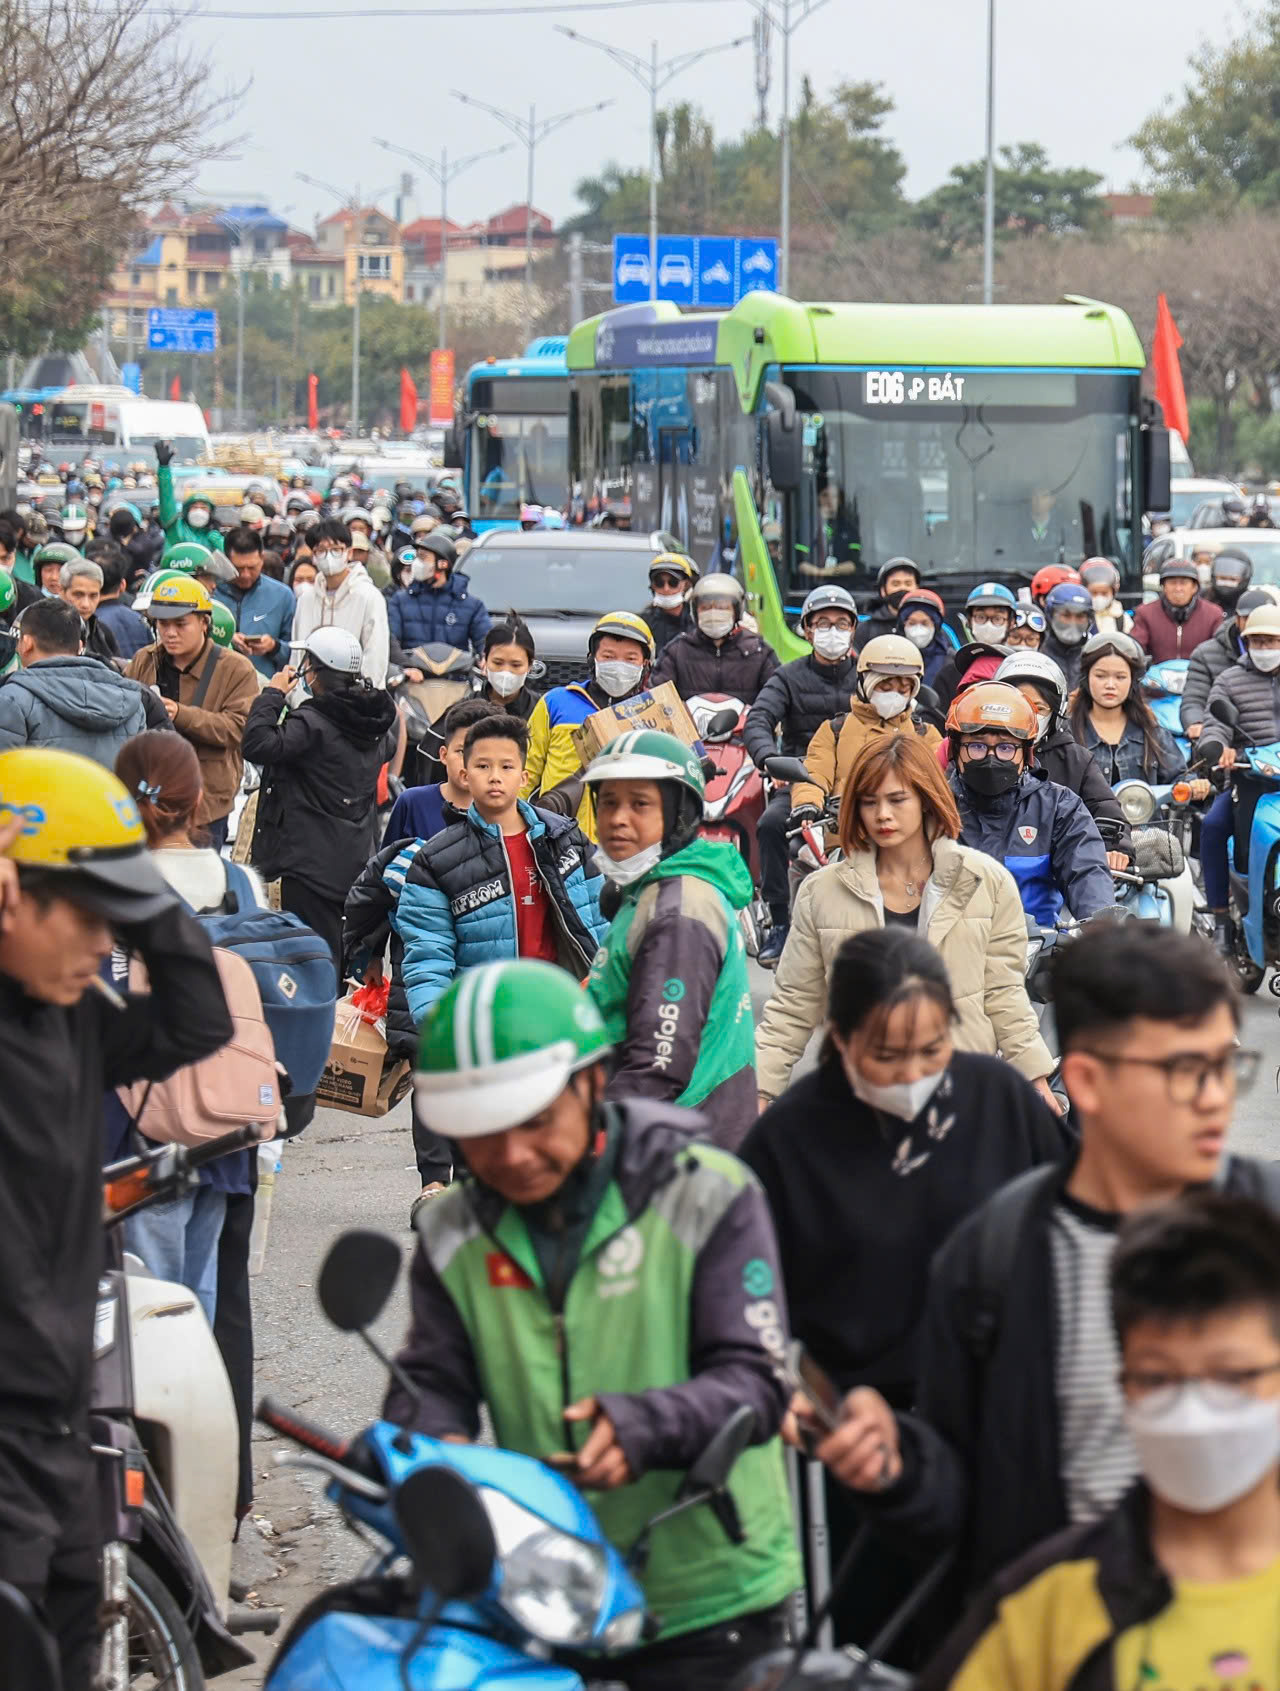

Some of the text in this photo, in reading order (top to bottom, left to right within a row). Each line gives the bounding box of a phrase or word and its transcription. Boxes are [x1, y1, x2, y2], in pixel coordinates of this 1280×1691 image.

[866, 371, 904, 404] E06
[928, 372, 965, 401] BÁT
[111, 945, 128, 981] TRU
[652, 1003, 680, 1071] gojek
